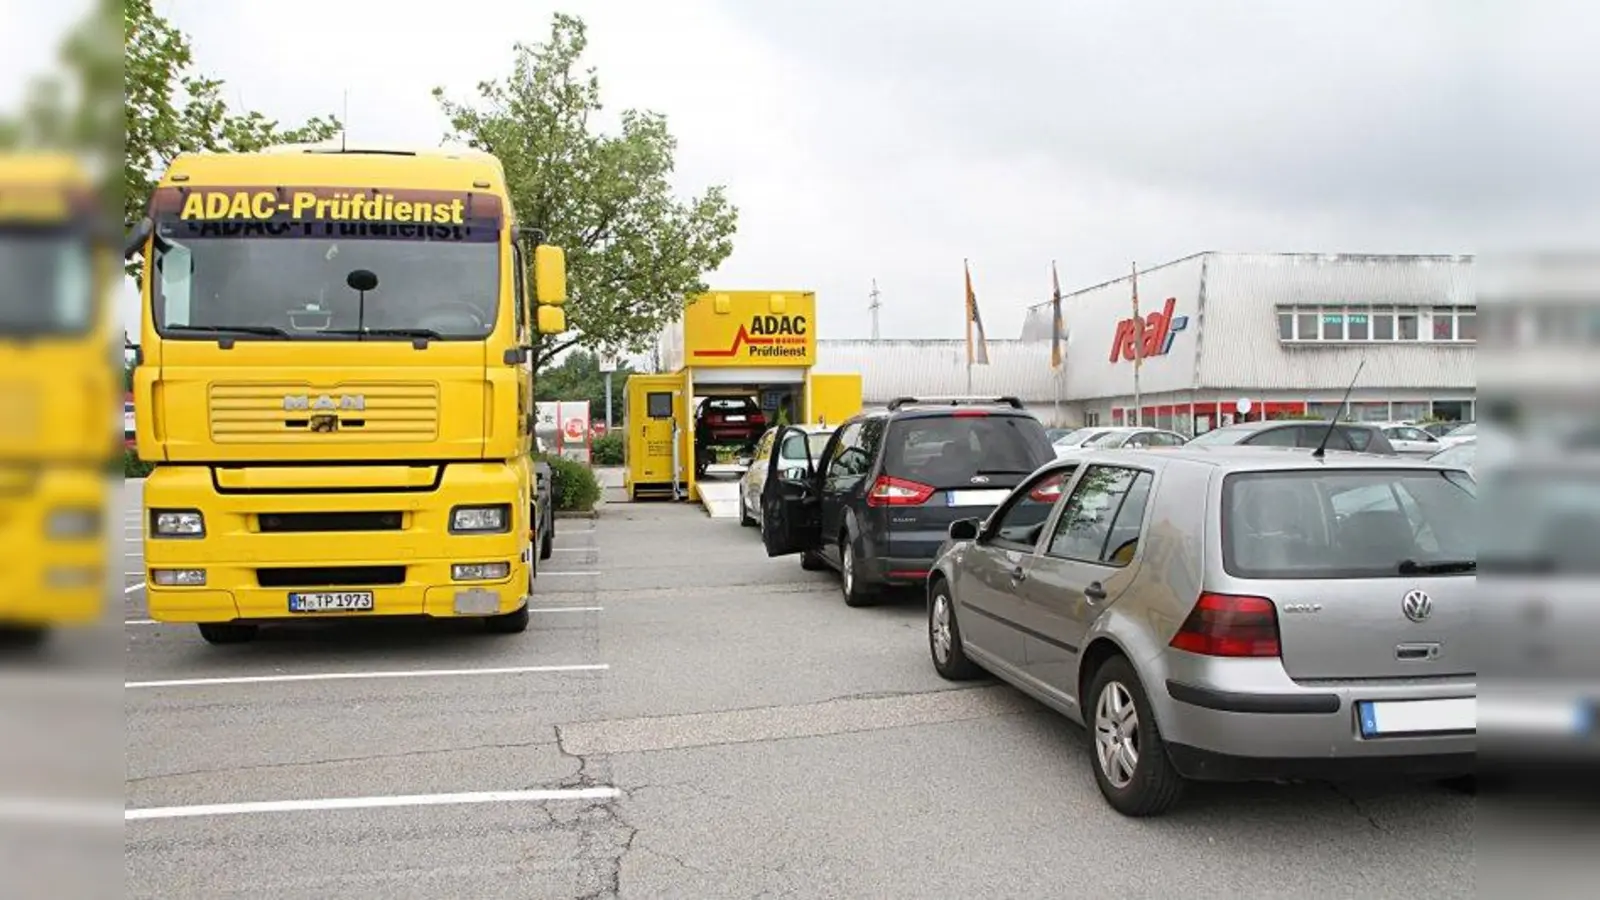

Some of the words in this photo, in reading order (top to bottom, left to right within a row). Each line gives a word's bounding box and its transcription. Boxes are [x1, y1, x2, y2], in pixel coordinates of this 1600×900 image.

[180, 192, 464, 223] ADAC-Prüfdienst
[750, 315, 806, 335] ADAC
[749, 345, 806, 357] Prüfdienst
[283, 394, 366, 411] MAN
[316, 595, 333, 607] TP
[336, 594, 370, 607] 1973
[1283, 603, 1322, 614] GOLF
